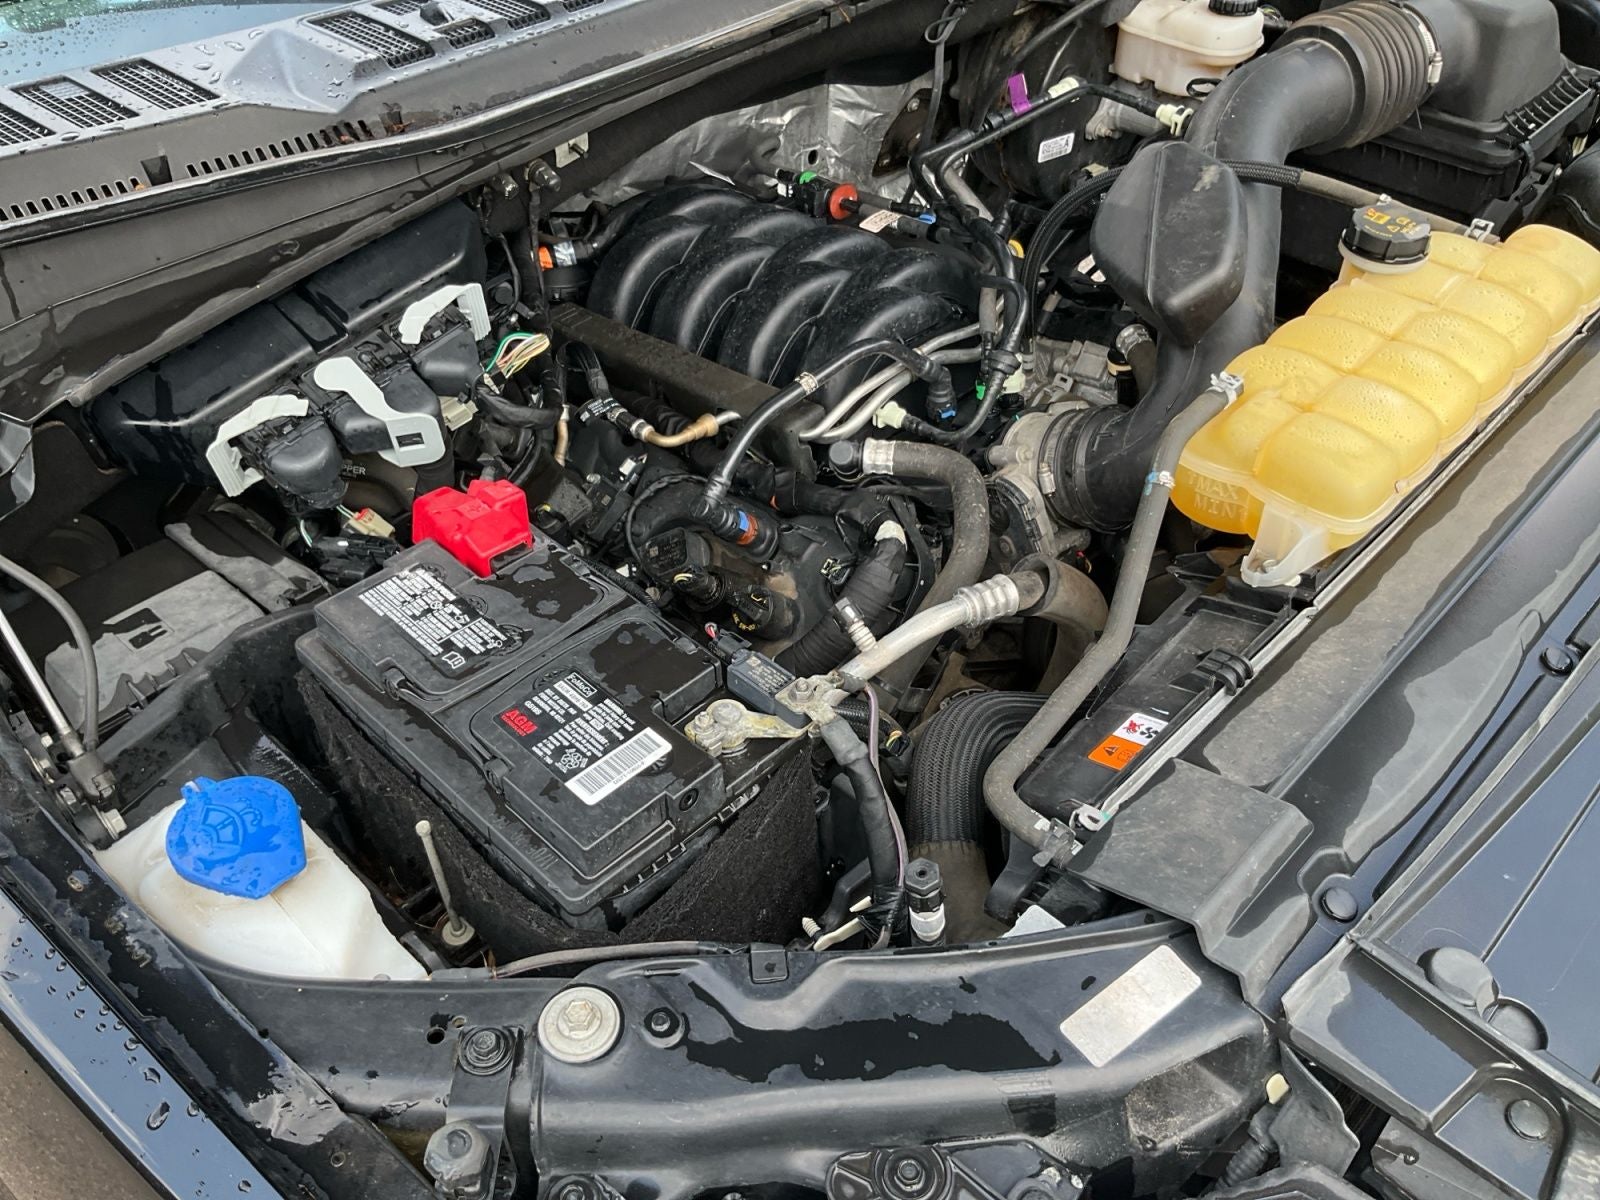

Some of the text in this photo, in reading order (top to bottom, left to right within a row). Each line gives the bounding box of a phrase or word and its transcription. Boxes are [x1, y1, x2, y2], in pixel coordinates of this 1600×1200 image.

[1196, 477, 1239, 500] MAX
[1194, 494, 1237, 519] MIN
[566, 674, 593, 695] FoMoCo
[507, 709, 538, 735] AGM
